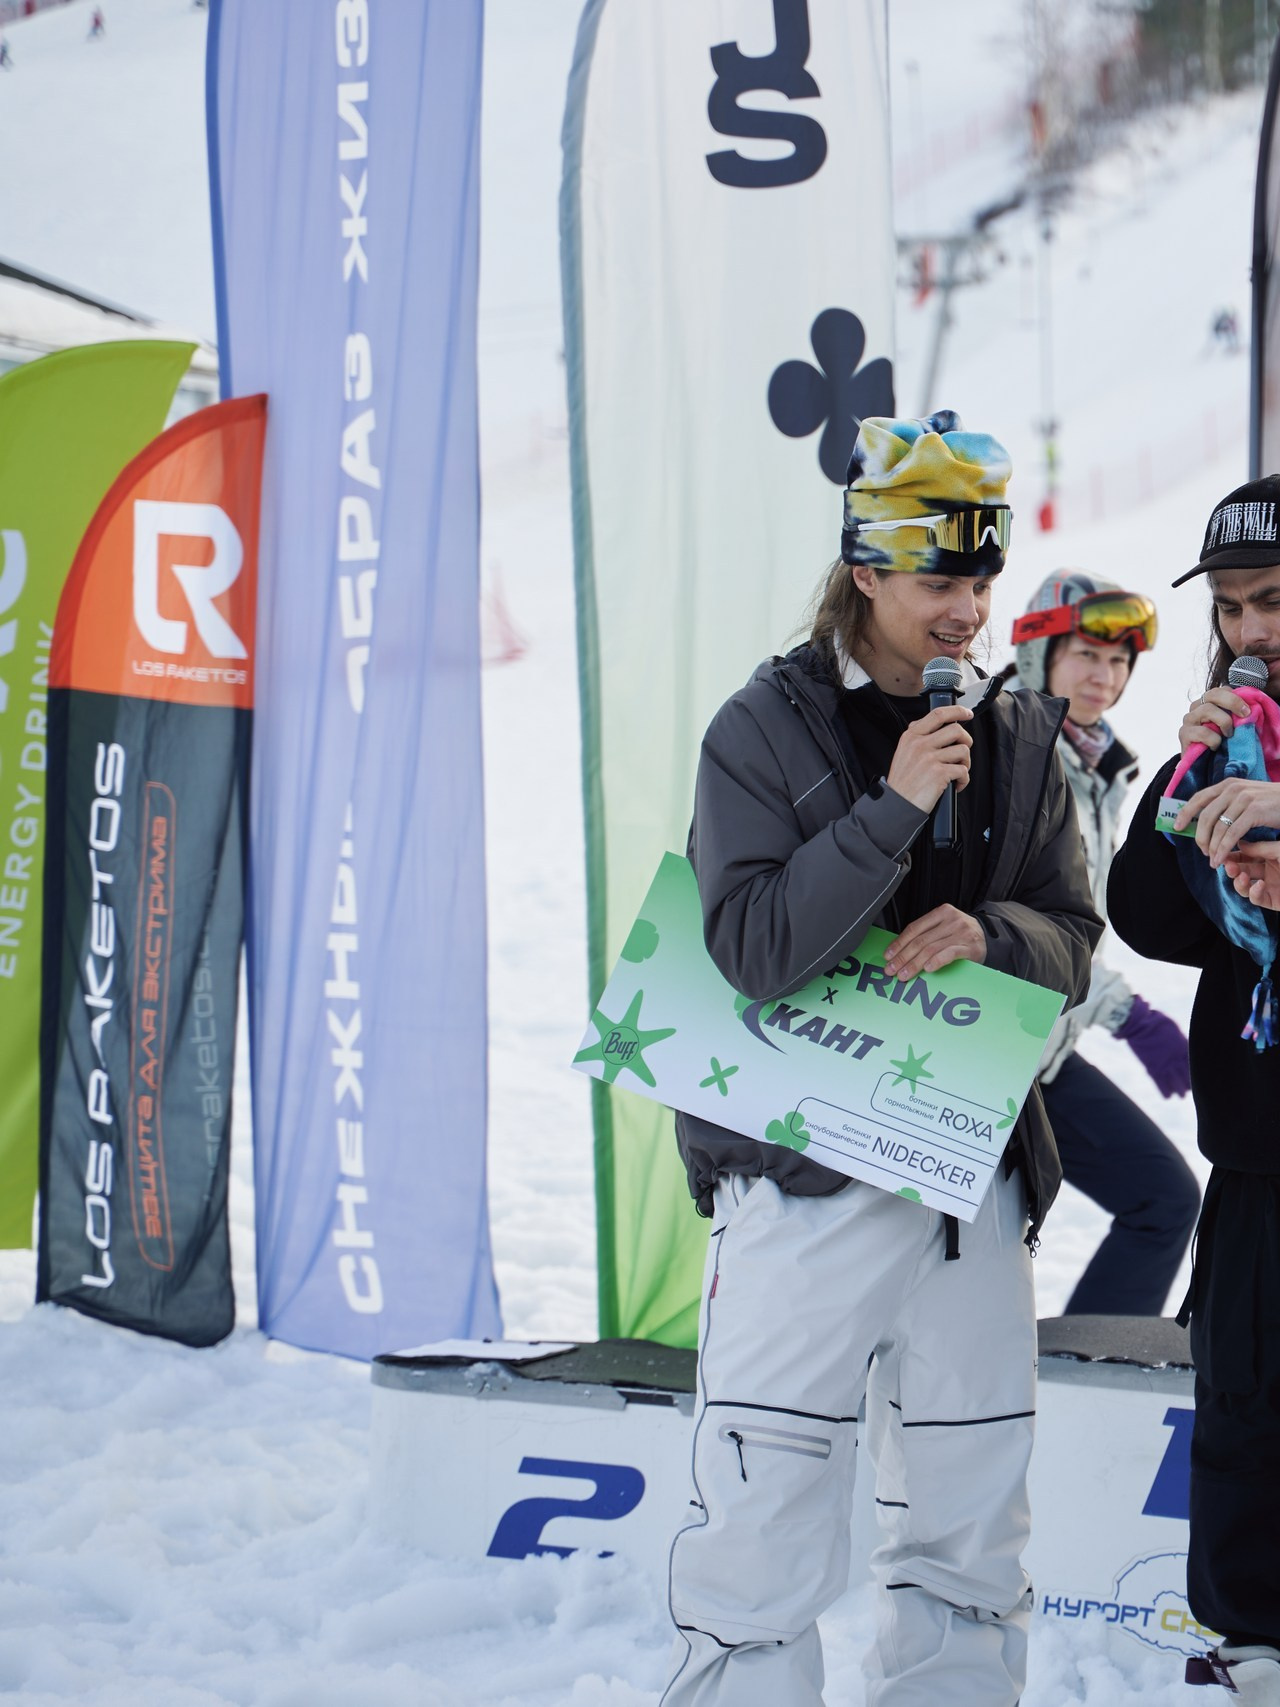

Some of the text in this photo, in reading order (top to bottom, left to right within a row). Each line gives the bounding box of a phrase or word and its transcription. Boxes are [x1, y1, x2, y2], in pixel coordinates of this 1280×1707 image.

[1243, 508, 1277, 535] WALL
[132, 659, 165, 678] LOS
[0, 783, 43, 980] ENERGY
[823, 955, 981, 1027] PRING
[763, 1002, 885, 1061] КАНТ
[884, 1097, 935, 1121] горнолыжные
[908, 1094, 939, 1112] ботинки
[804, 1121, 868, 1150] сноубордические
[841, 1123, 872, 1140] ботинки
[937, 1106, 993, 1143] ROXA
[871, 1136, 977, 1190] NIDECKER
[81, 1139, 116, 1289] LOS
[486, 1456, 646, 1560] 2
